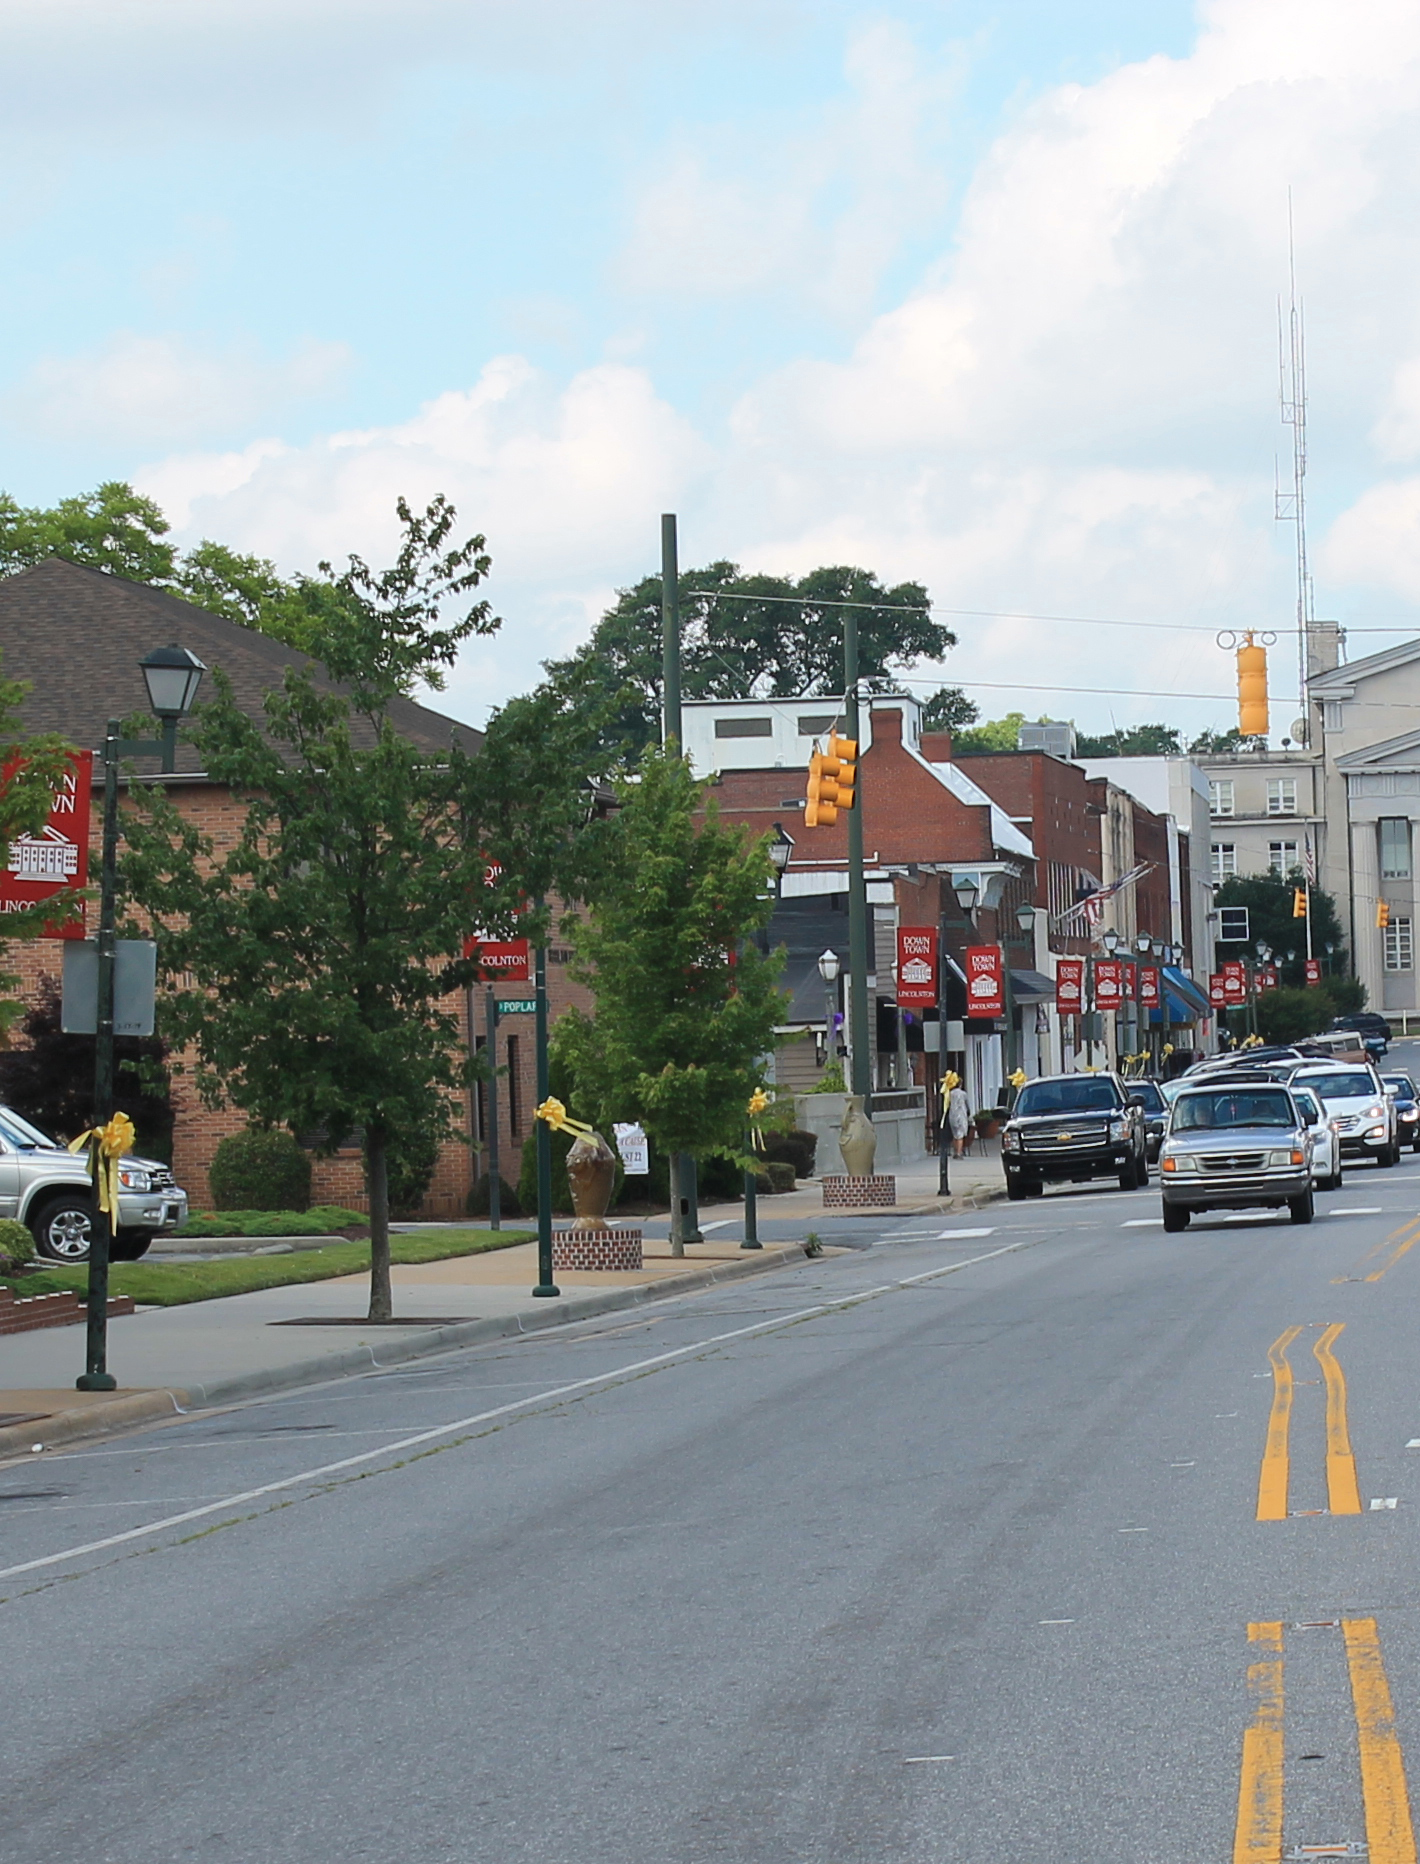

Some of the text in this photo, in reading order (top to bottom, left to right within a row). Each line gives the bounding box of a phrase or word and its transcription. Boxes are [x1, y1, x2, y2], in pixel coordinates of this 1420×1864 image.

[903, 936, 930, 945] DOWN
[904, 944, 930, 954] TOWN
[480, 955, 527, 967] COLNTON
[971, 955, 995, 964] DOWN
[973, 963, 995, 972] TOWN
